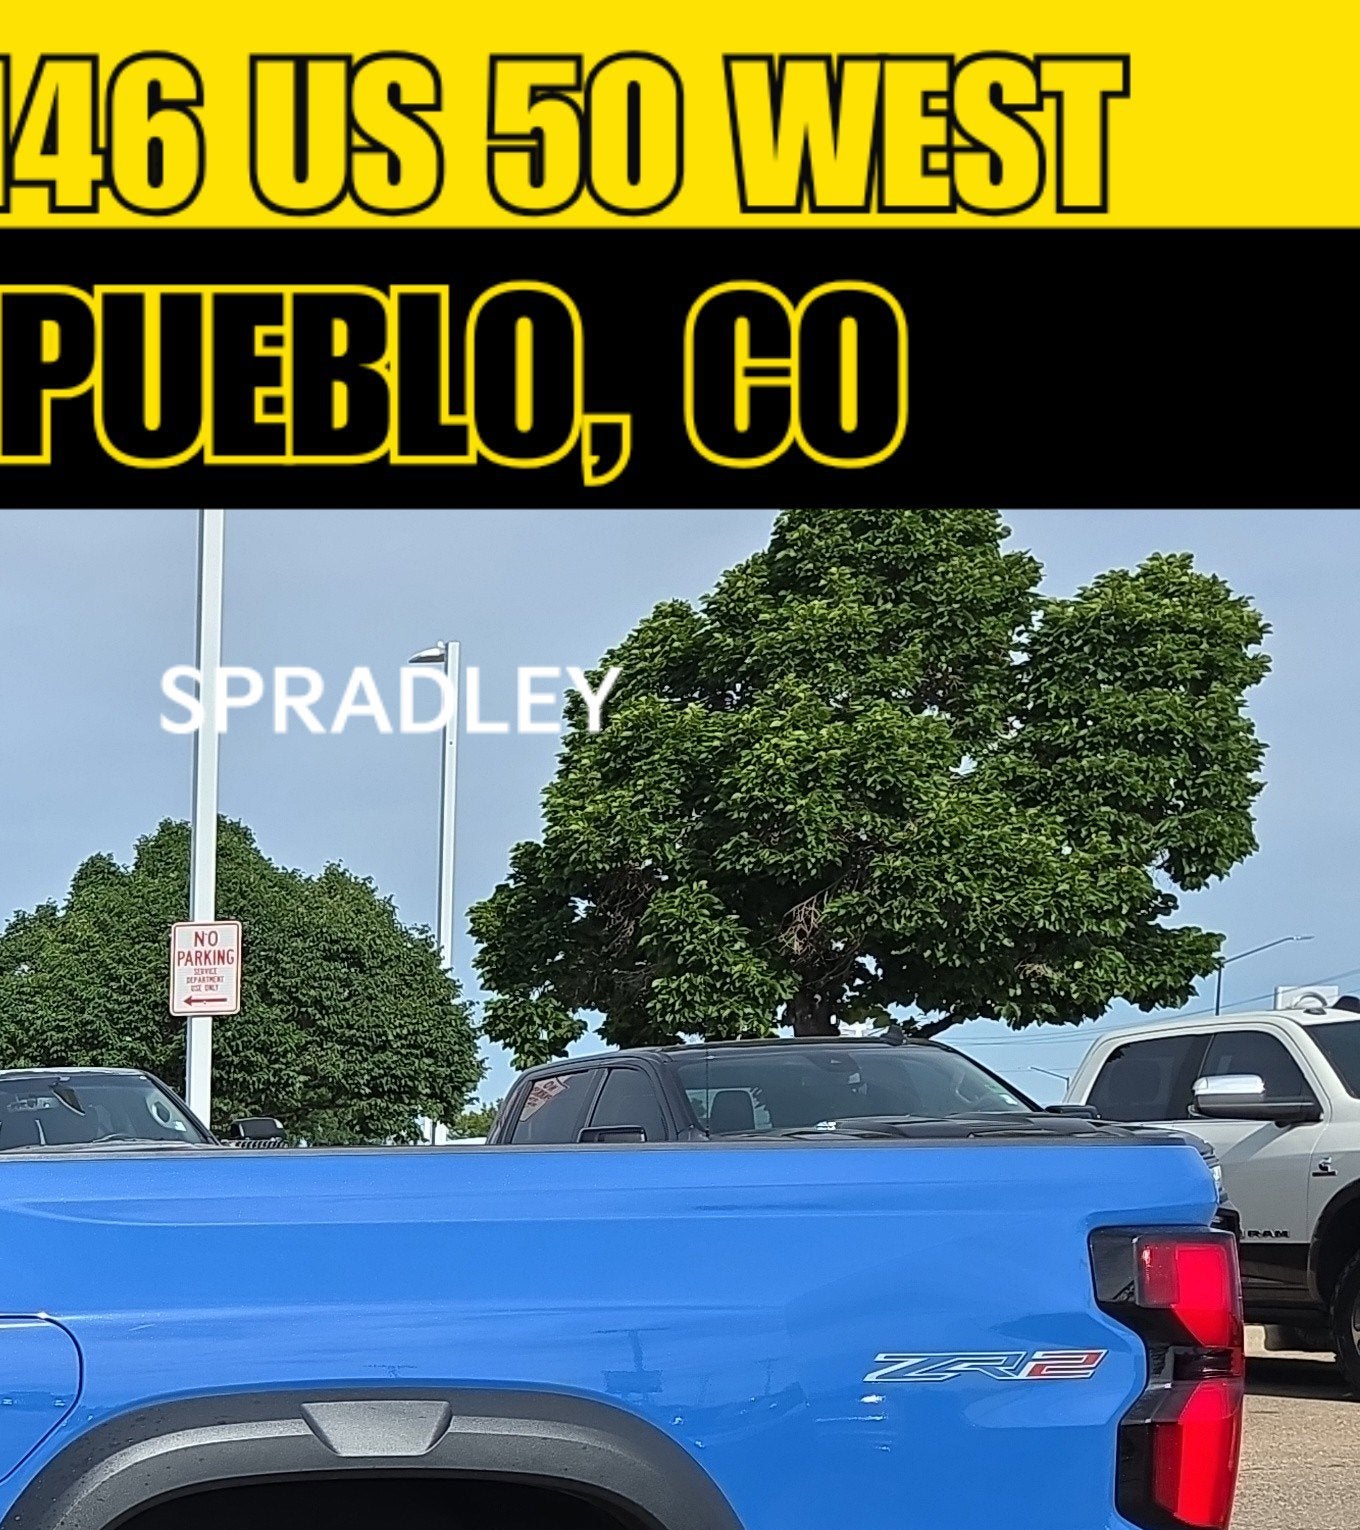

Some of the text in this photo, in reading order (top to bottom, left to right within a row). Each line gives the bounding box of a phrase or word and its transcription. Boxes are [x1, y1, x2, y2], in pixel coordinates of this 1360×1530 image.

[194, 930, 219, 947] NO
[177, 949, 235, 967] PARKING
[1247, 1230, 1290, 1239] RAM
[862, 1349, 1109, 1382] ZR2
